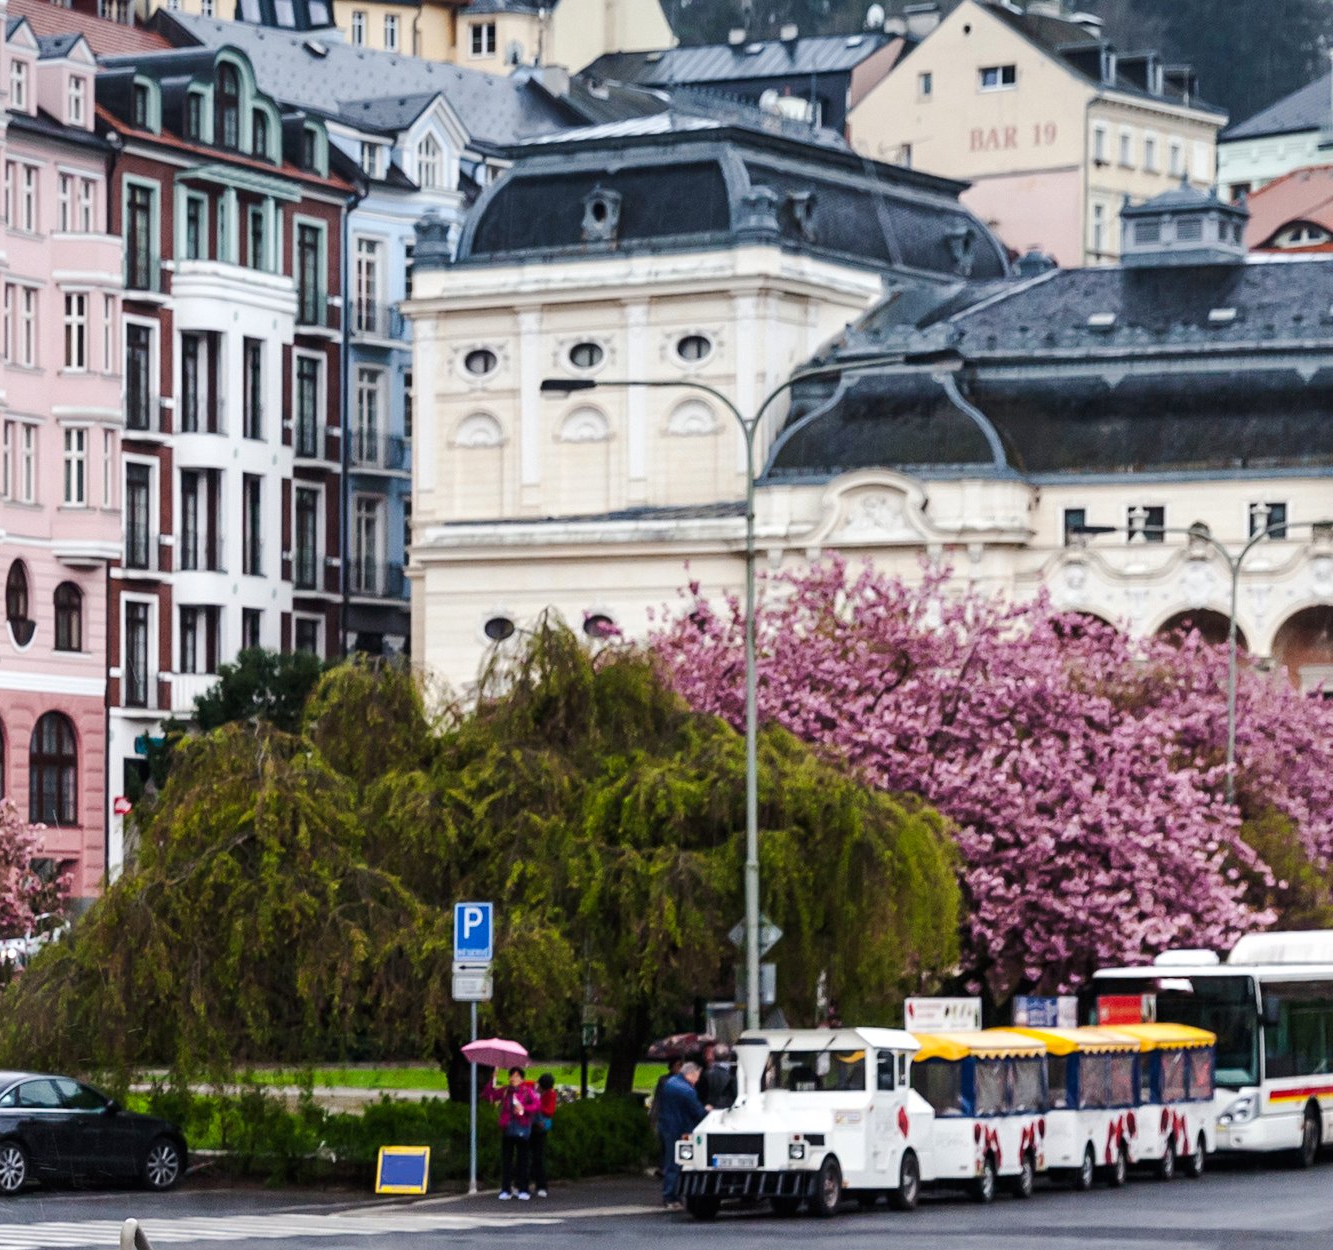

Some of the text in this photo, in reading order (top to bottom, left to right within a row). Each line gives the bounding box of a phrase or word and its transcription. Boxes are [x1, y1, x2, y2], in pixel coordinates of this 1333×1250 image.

[969, 120, 1058, 152] BAR 19
[463, 907, 483, 939] P
